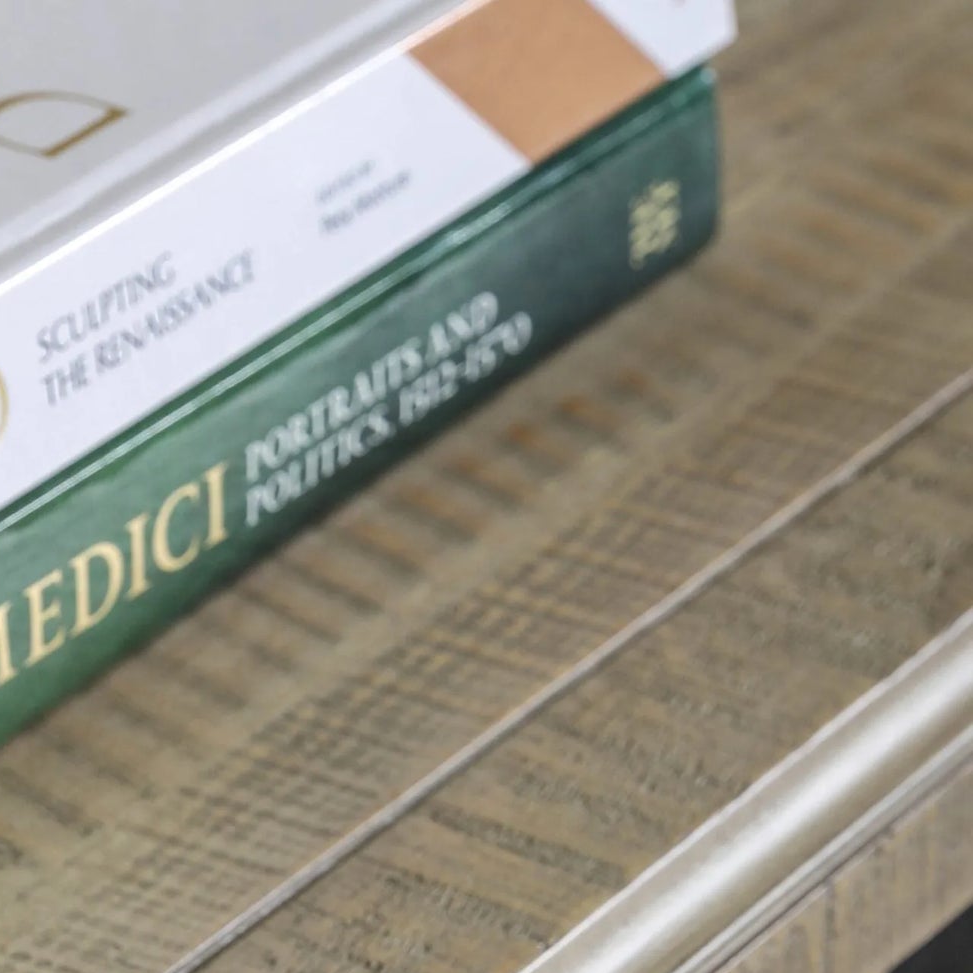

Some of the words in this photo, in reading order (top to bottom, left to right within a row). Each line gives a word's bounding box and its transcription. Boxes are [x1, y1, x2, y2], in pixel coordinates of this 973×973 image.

[34, 251, 177, 364] SCULPTING
[40, 352, 91, 406] THE
[93, 248, 256, 374] RENAISSANCE
[245, 336, 423, 482] PORTRAITS
[426, 291, 498, 366] AND
